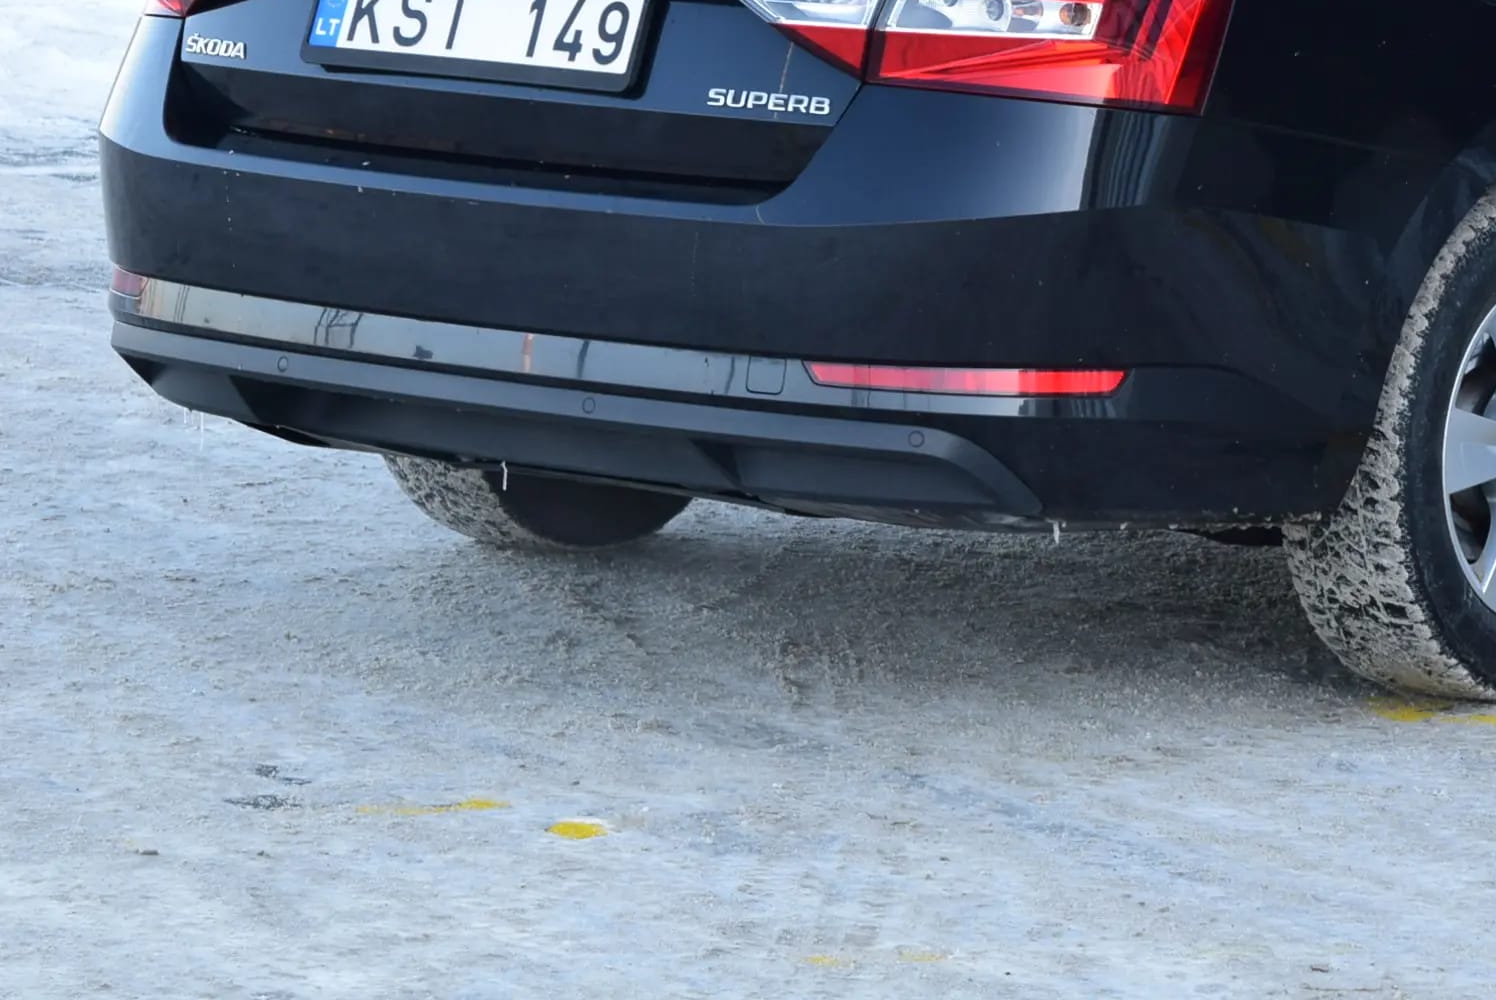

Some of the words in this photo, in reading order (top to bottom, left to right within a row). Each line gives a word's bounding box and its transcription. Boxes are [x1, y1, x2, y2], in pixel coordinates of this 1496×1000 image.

[315, 17, 341, 36] LT
[185, 32, 245, 59] ŠKODA
[706, 87, 831, 115] SUPERB
